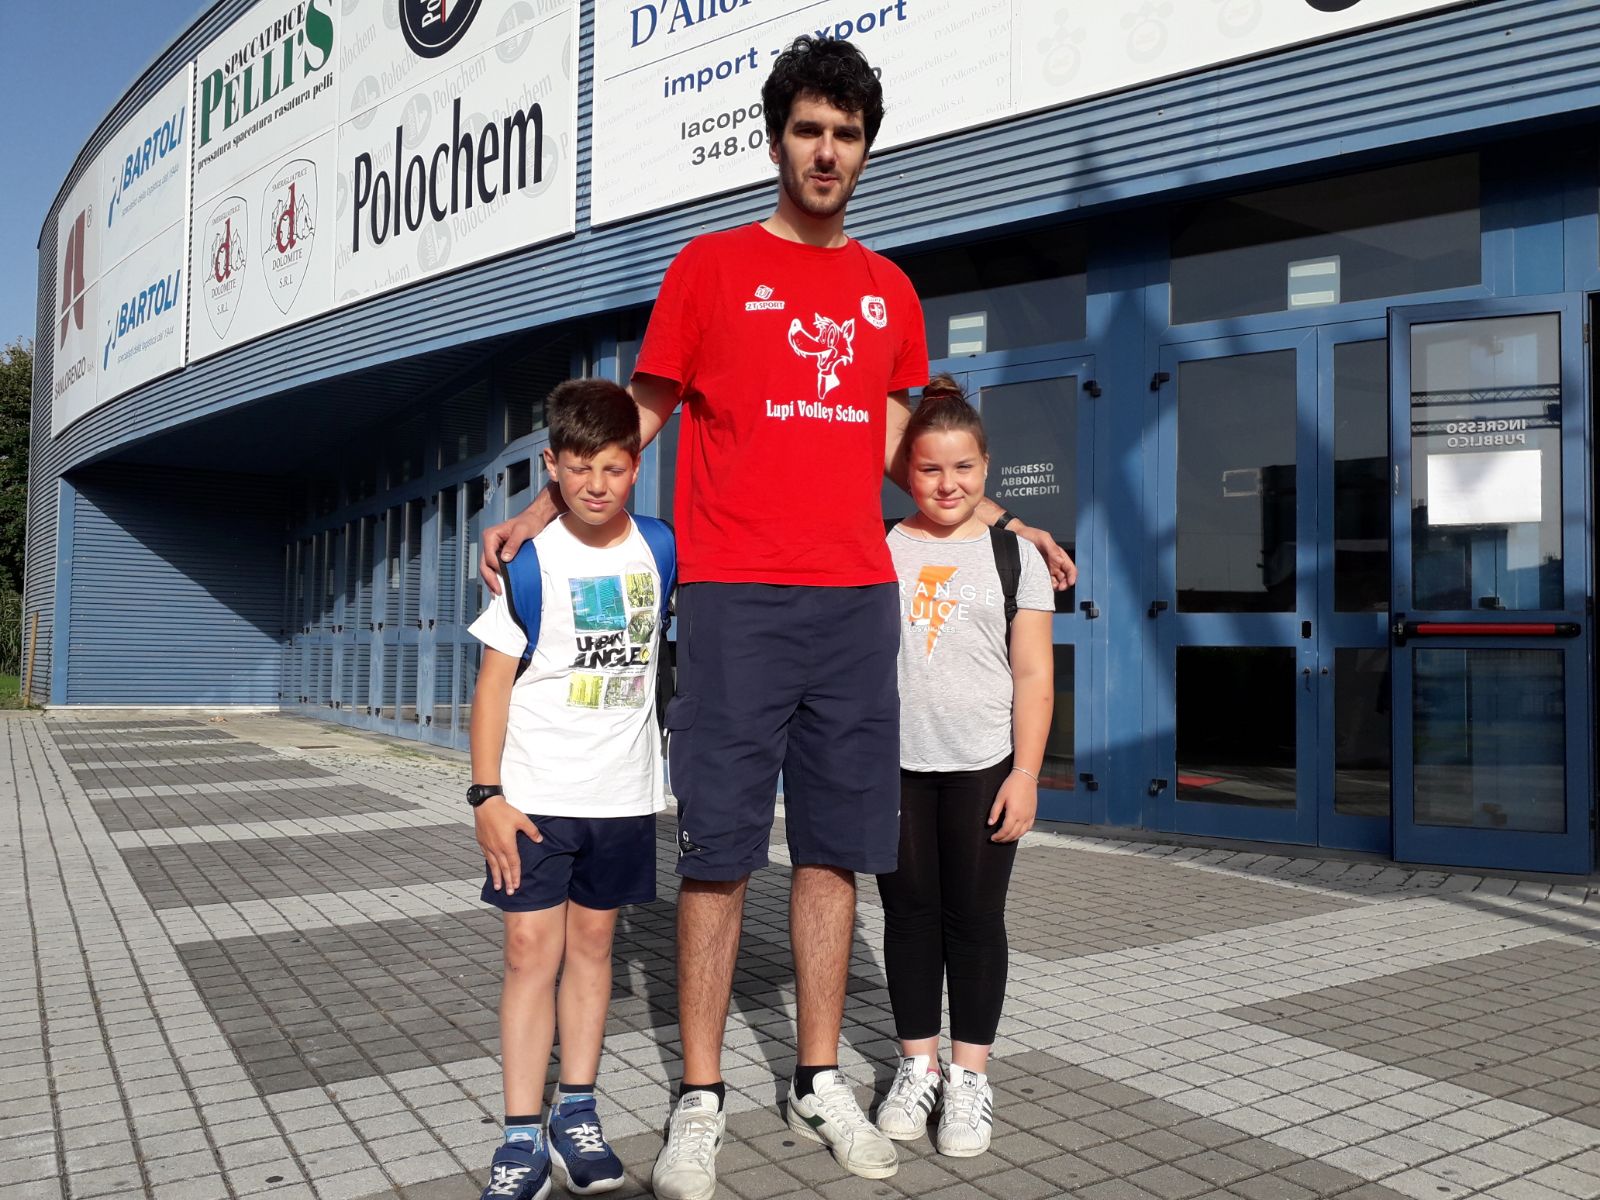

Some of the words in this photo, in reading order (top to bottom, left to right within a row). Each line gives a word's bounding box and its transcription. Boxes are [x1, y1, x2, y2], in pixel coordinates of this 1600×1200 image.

[224, 1, 306, 79] SPACCATRICE
[664, 47, 758, 98] import
[799, 0, 908, 41] xport
[198, 0, 334, 149] PELLI'S
[274, 88, 311, 120] rasatura
[312, 72, 334, 100] pelli
[123, 105, 185, 191] BARTOLI
[692, 129, 770, 165] 348.0
[353, 97, 543, 253] Polochem
[272, 248, 303, 270] DOLOMITE
[118, 269, 181, 338] BARTOLI
[211, 279, 237, 298] DOLOMITE
[765, 400, 794, 421] Lupi
[797, 400, 833, 423] Volley
[1001, 462, 1054, 475] INGRESSO
[1001, 474, 1055, 487] ABBONATI
[1004, 485, 1060, 497] ACCREDITI
